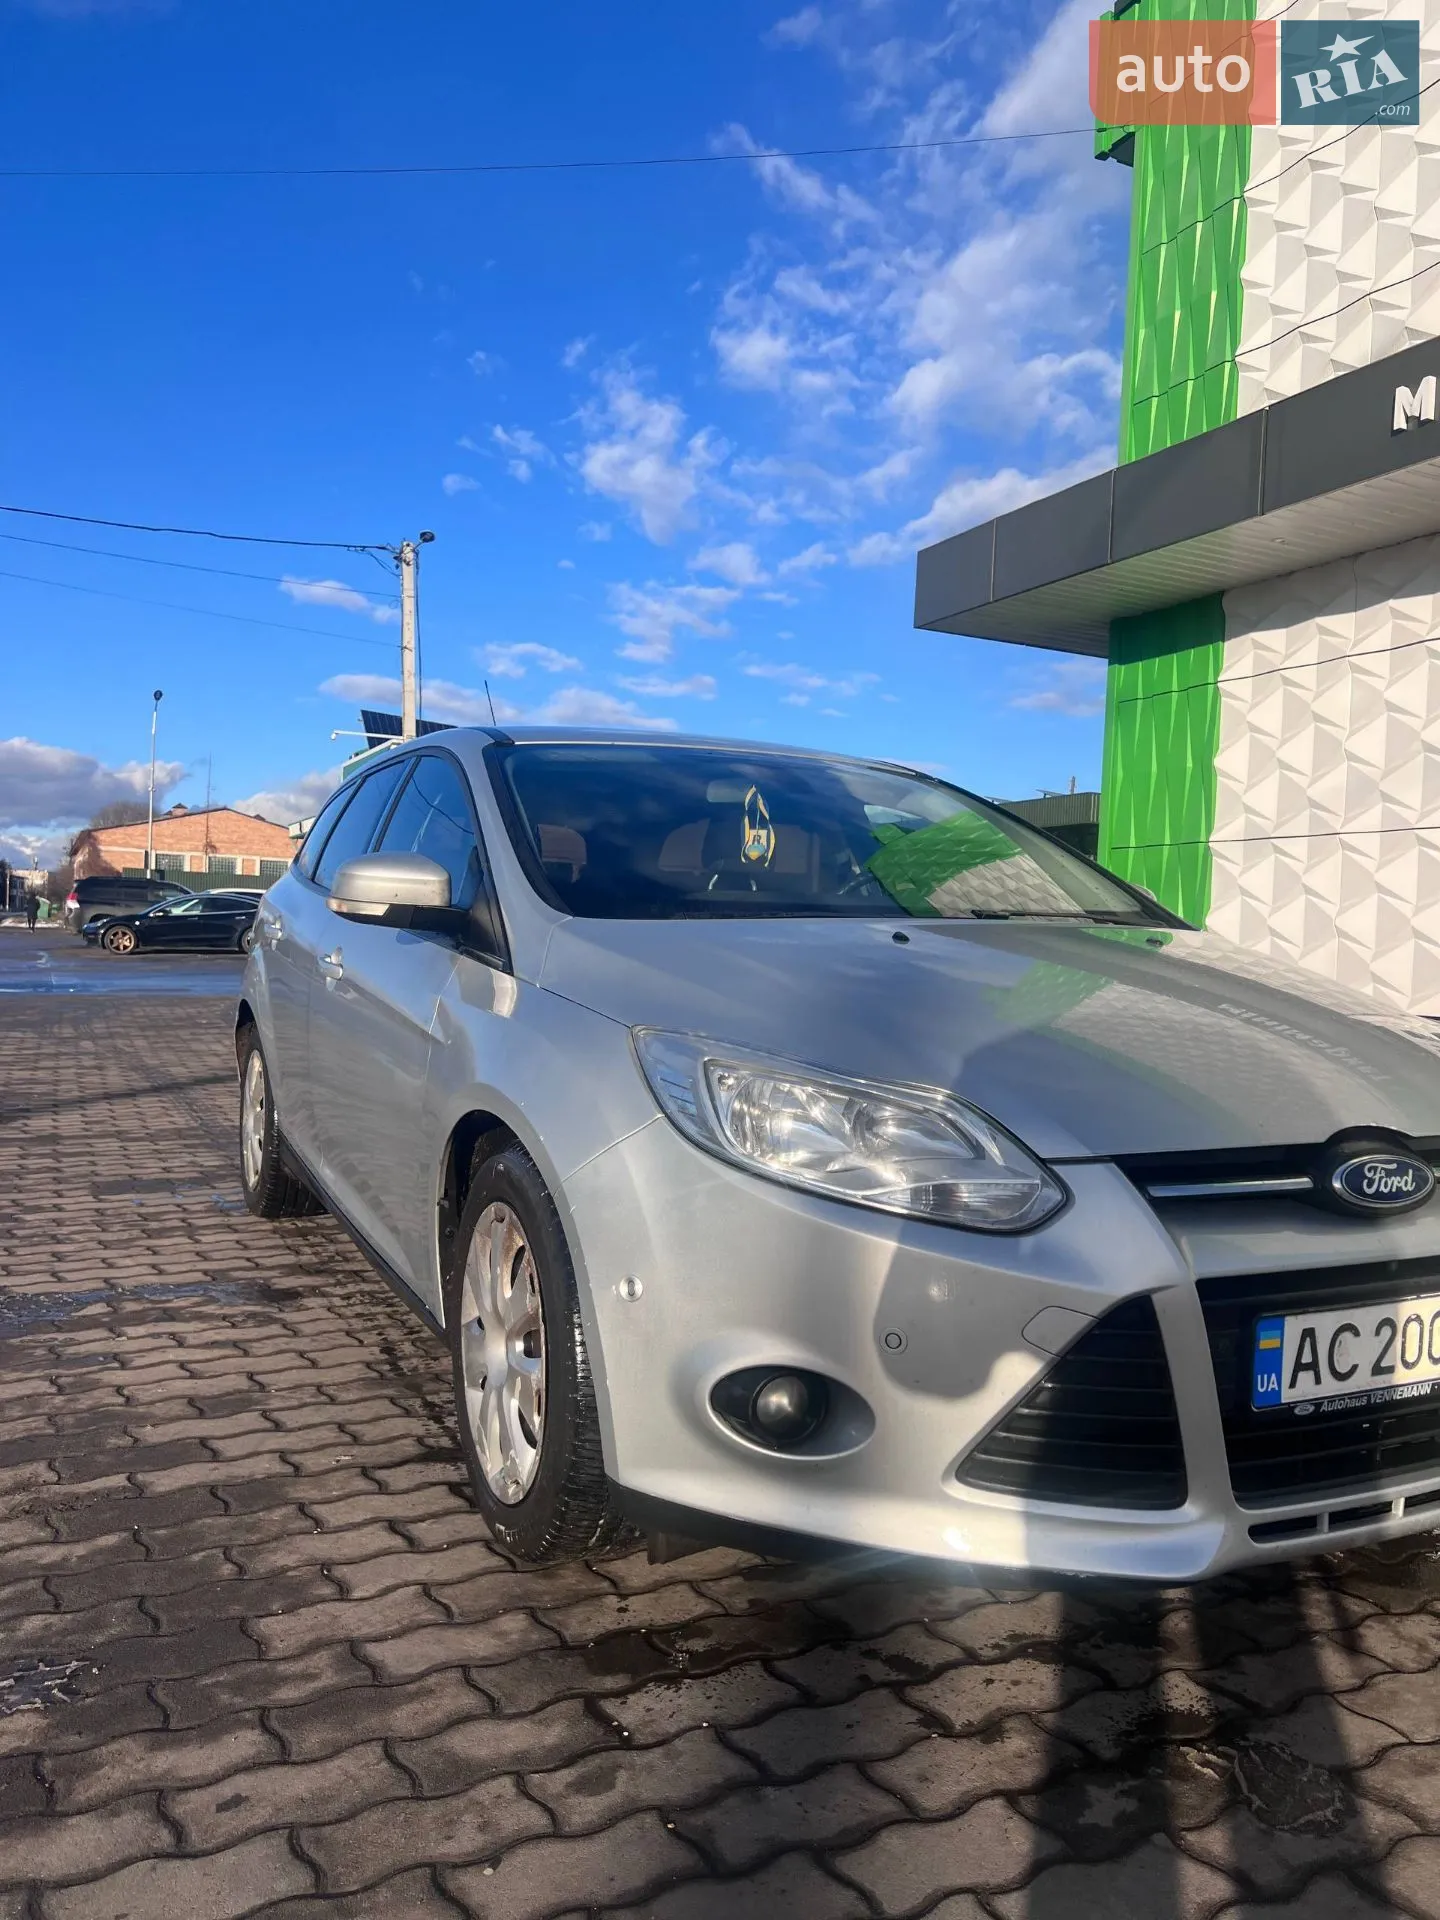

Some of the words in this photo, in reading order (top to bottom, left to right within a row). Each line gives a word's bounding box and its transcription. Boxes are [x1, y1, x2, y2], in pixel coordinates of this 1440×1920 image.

[1362, 1163, 1416, 1195] Ford
[1288, 1322, 1362, 1390] AC
[1257, 1373, 1279, 1393] UA
[1320, 1396, 1368, 1413] Autohaus
[1370, 1384, 1432, 1405] VENNEMANN
